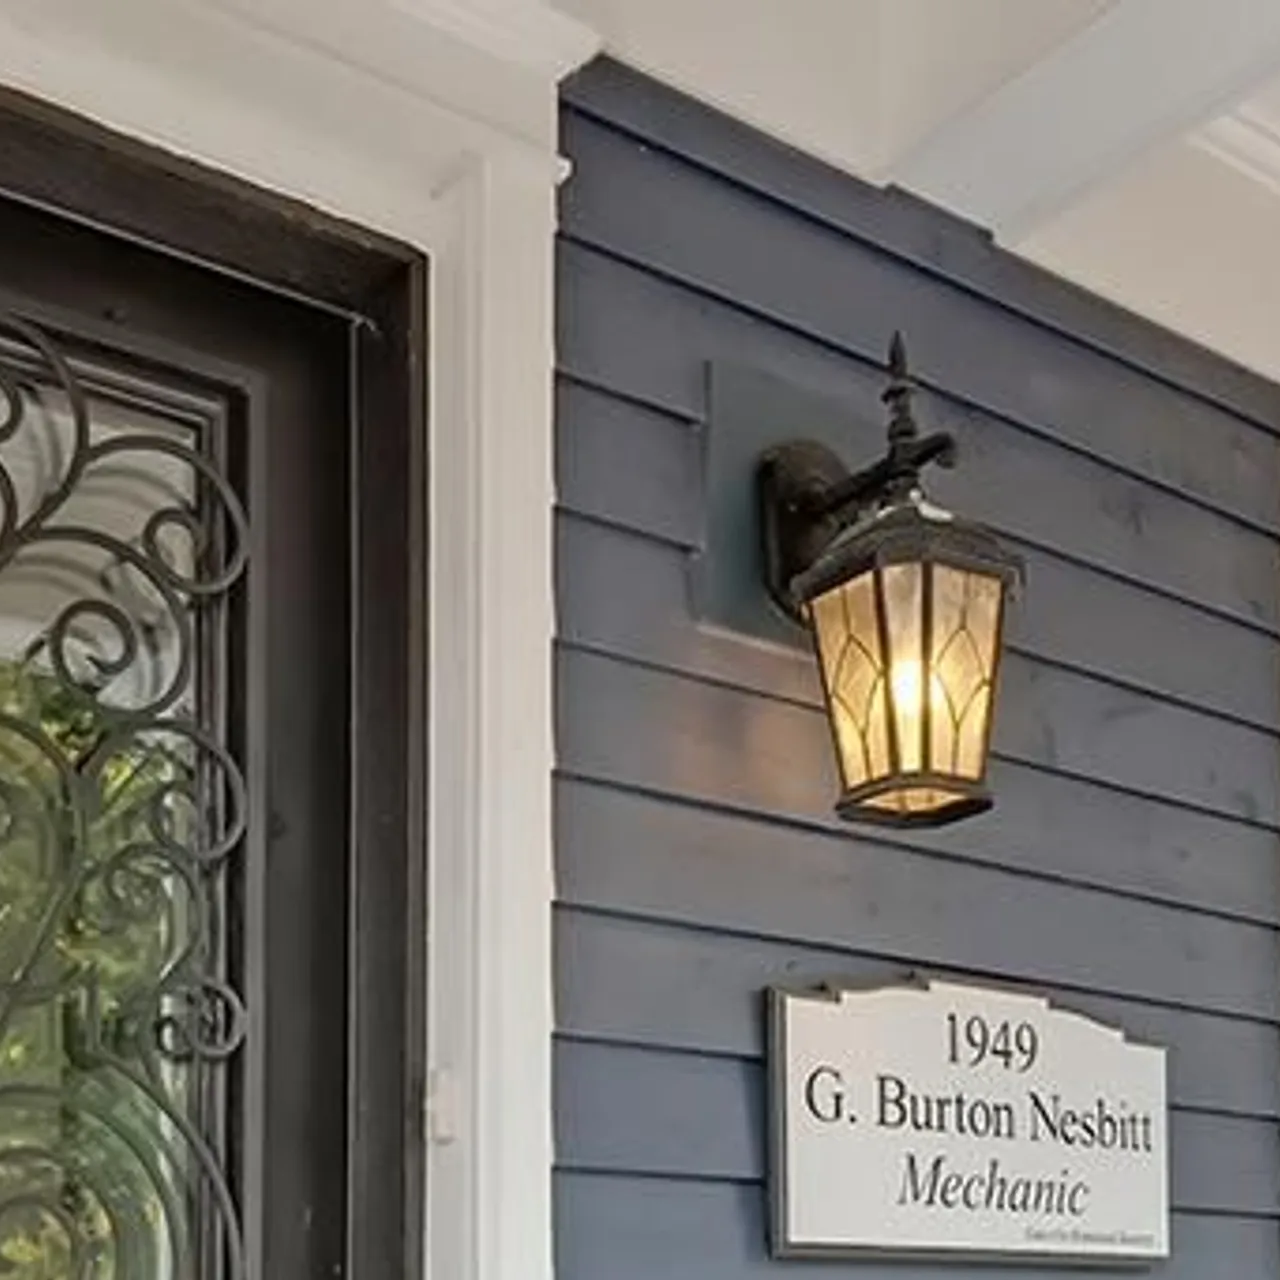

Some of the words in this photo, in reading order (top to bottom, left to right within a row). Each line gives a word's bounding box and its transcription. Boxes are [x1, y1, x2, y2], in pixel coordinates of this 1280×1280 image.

[947, 1012, 1038, 1074] 1949
[804, 1066, 856, 1124] G.
[877, 1076, 1014, 1140] Burton
[1029, 1092, 1152, 1153] Nesbitt
[898, 1153, 1090, 1216] Mechanic
